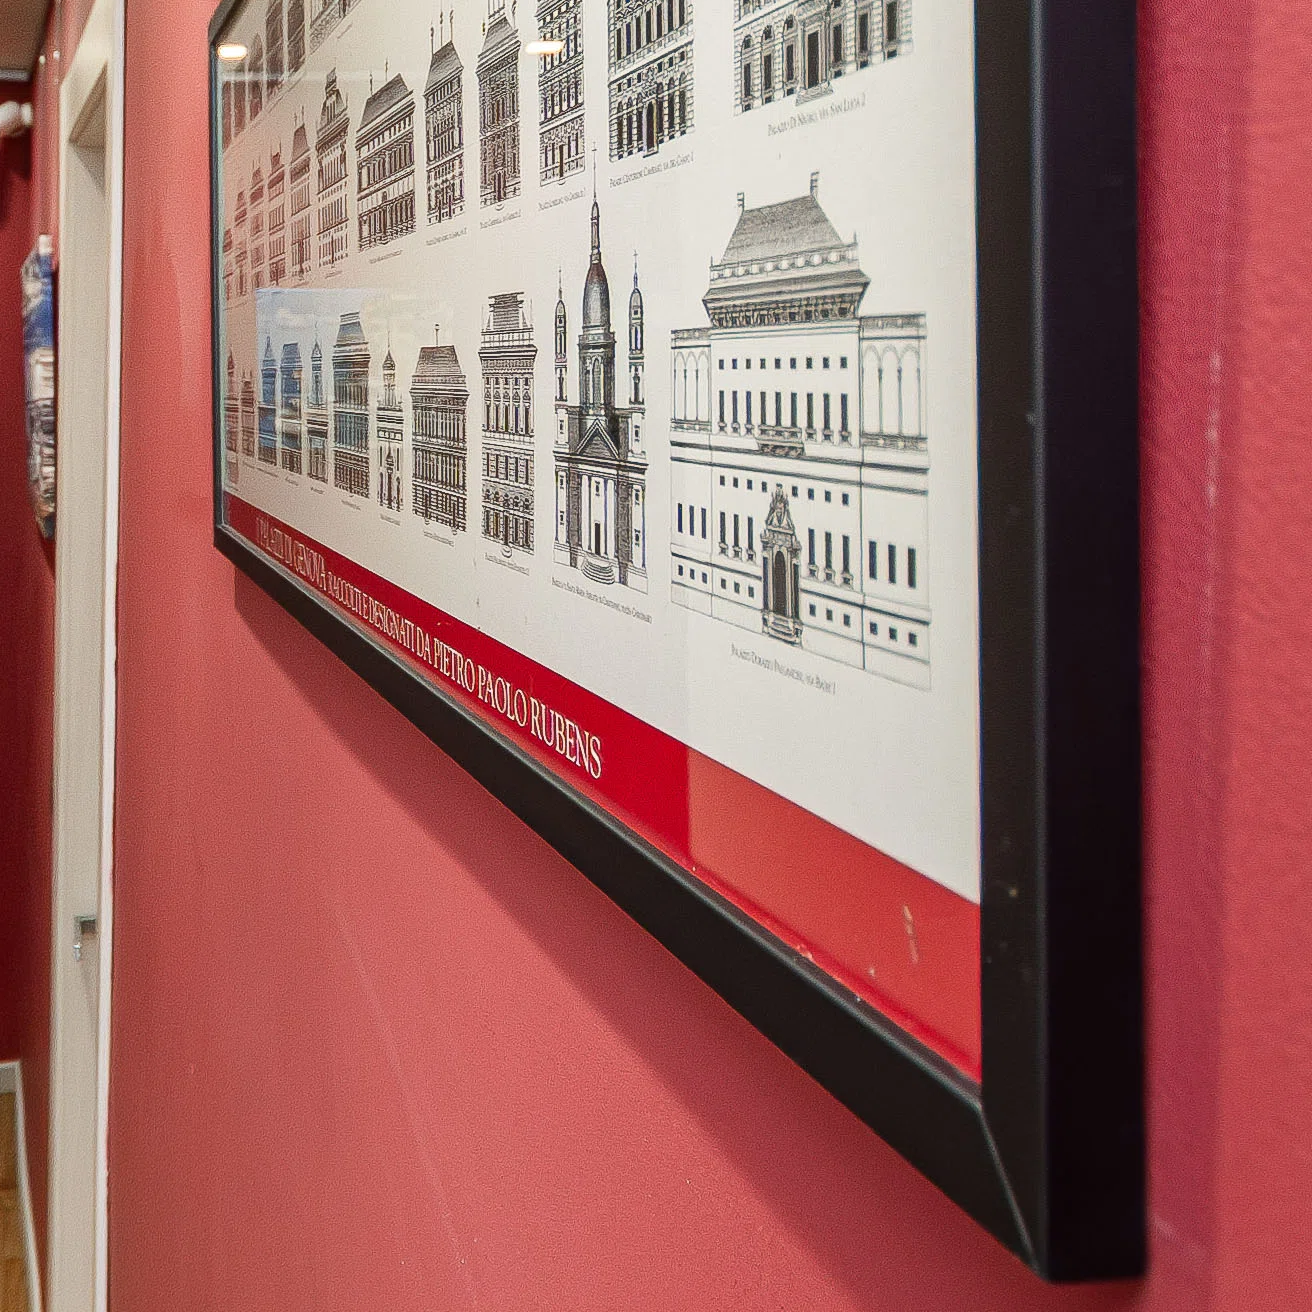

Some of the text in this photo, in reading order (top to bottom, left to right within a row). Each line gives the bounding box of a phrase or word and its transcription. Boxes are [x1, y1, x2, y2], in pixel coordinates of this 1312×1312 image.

[293, 538, 327, 592] GENOVA
[368, 595, 416, 654] DESIGNATI
[416, 626, 433, 665] DA
[433, 637, 476, 693] PIETRO
[477, 664, 527, 727] PAOLO
[529, 696, 602, 779] RUBENS
